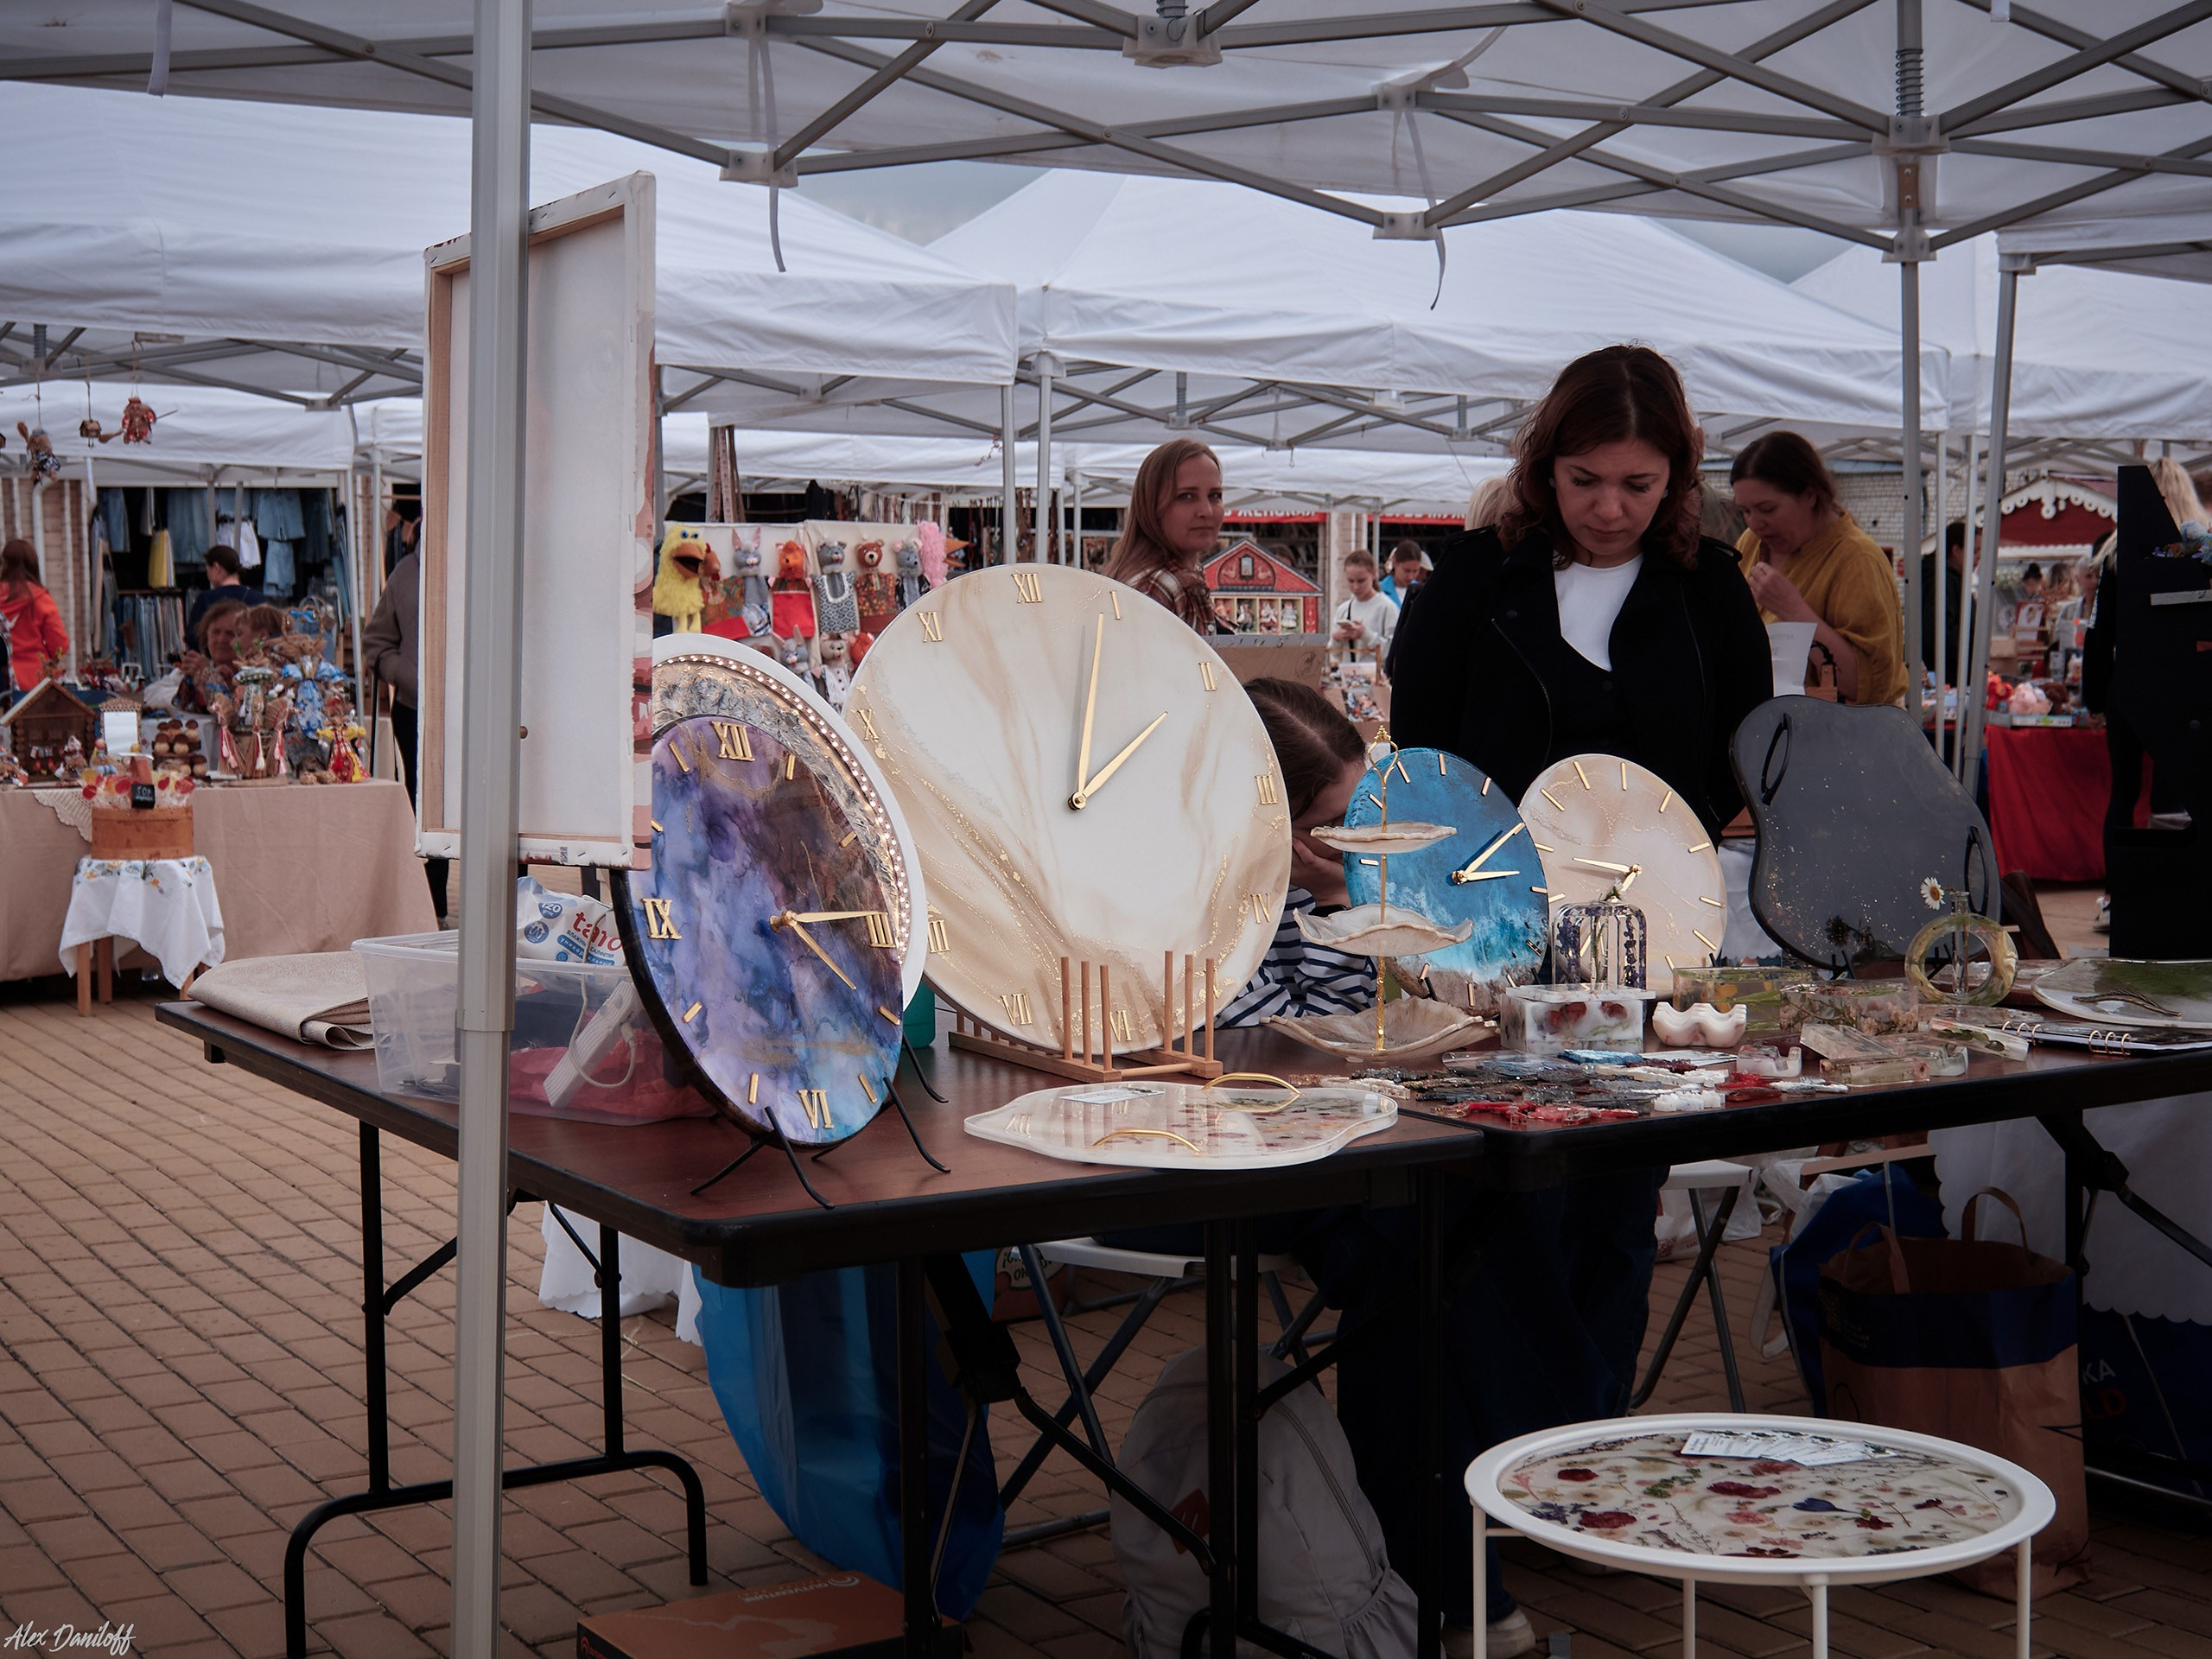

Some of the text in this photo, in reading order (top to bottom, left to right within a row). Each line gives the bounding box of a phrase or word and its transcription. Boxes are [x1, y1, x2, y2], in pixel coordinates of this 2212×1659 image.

[1012, 573, 1043, 603] XII
[917, 611, 944, 643] XI
[711, 721, 755, 761] XII
[1255, 773, 1278, 805] III
[641, 898, 682, 940] IX
[867, 912, 895, 949] III
[1000, 994, 1033, 1026] VII
[798, 1089, 835, 1129] VI
